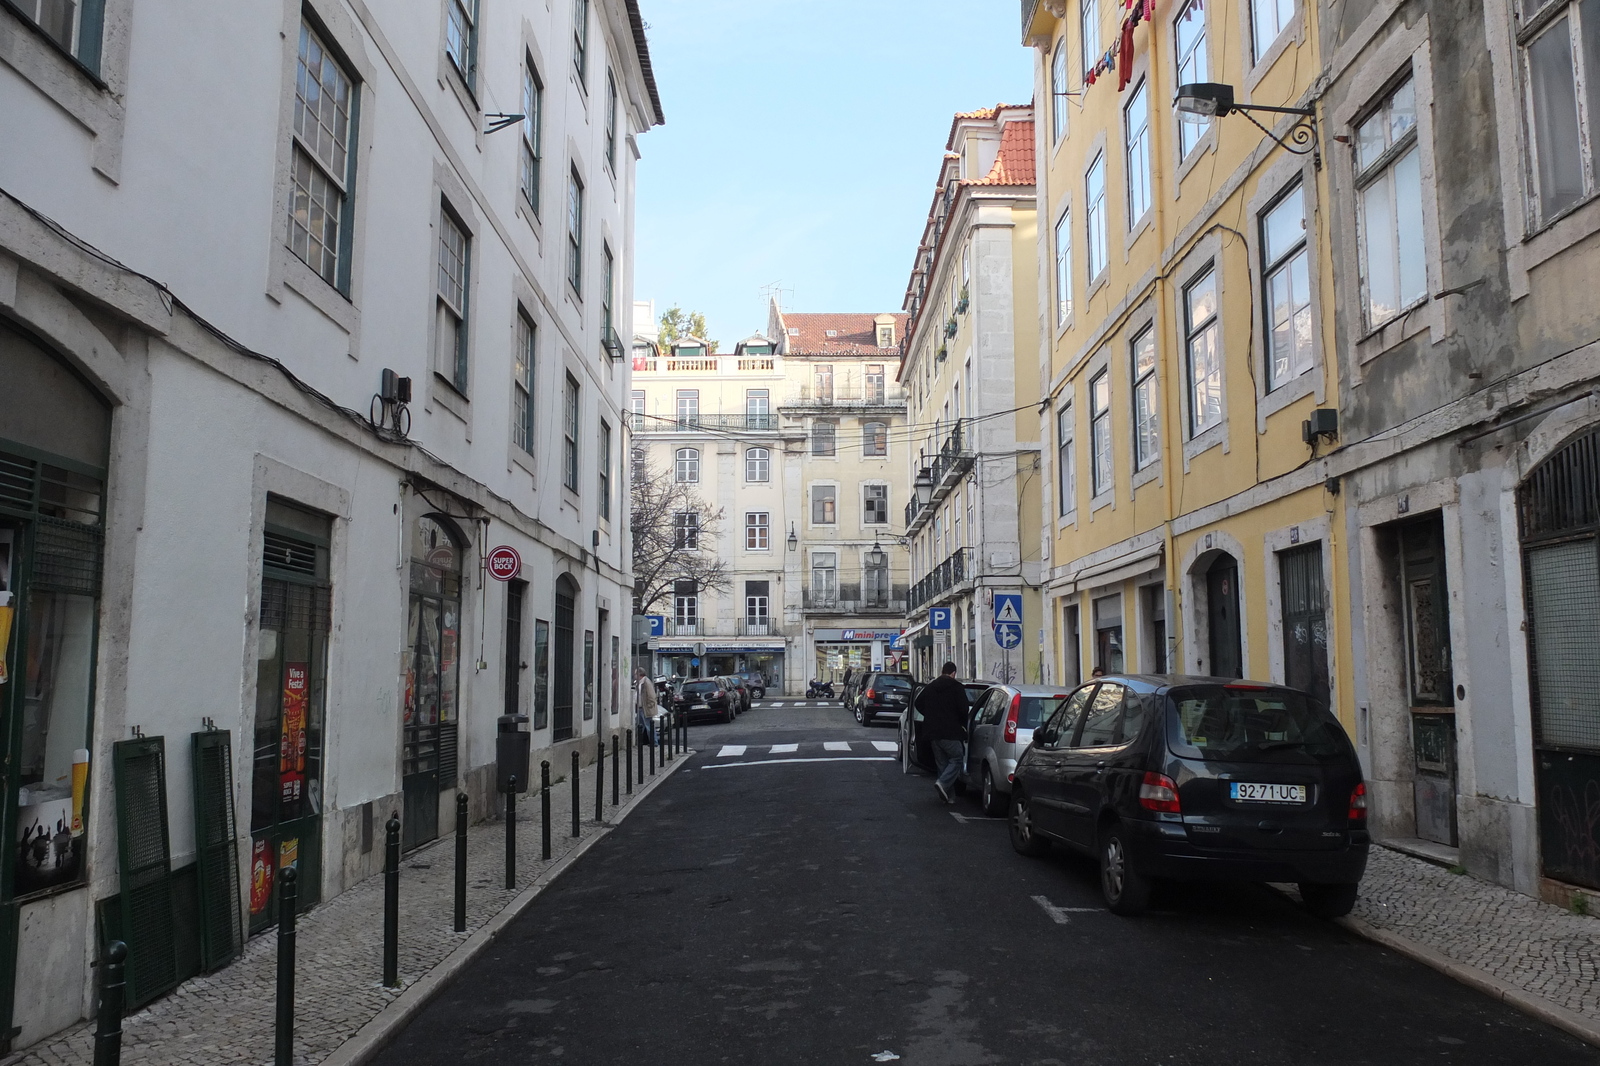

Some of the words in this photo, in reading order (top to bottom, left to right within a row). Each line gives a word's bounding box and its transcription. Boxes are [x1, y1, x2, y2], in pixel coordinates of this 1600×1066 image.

[934, 611, 946, 626] P
[289, 668, 300, 678] Vive
[288, 679, 304, 689] Festa!
